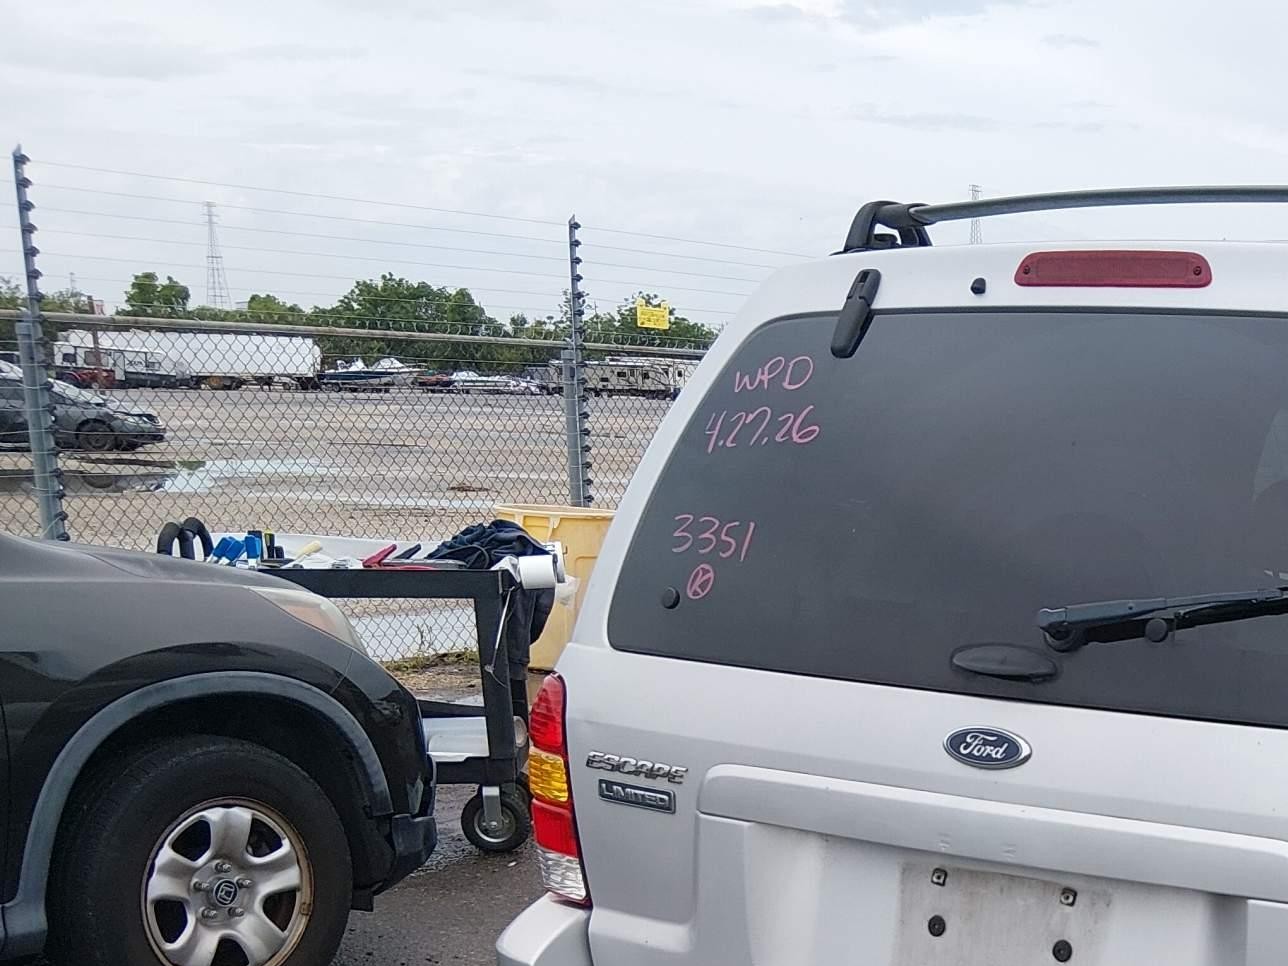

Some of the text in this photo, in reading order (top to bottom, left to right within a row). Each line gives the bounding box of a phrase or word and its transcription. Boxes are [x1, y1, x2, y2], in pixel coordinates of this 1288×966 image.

[734, 355, 815, 393] WPD
[671, 513, 756, 562] 3351
[959, 732, 1009, 759] Ford
[585, 750, 688, 784] ESCAPE
[600, 783, 670, 808] LIMITED
